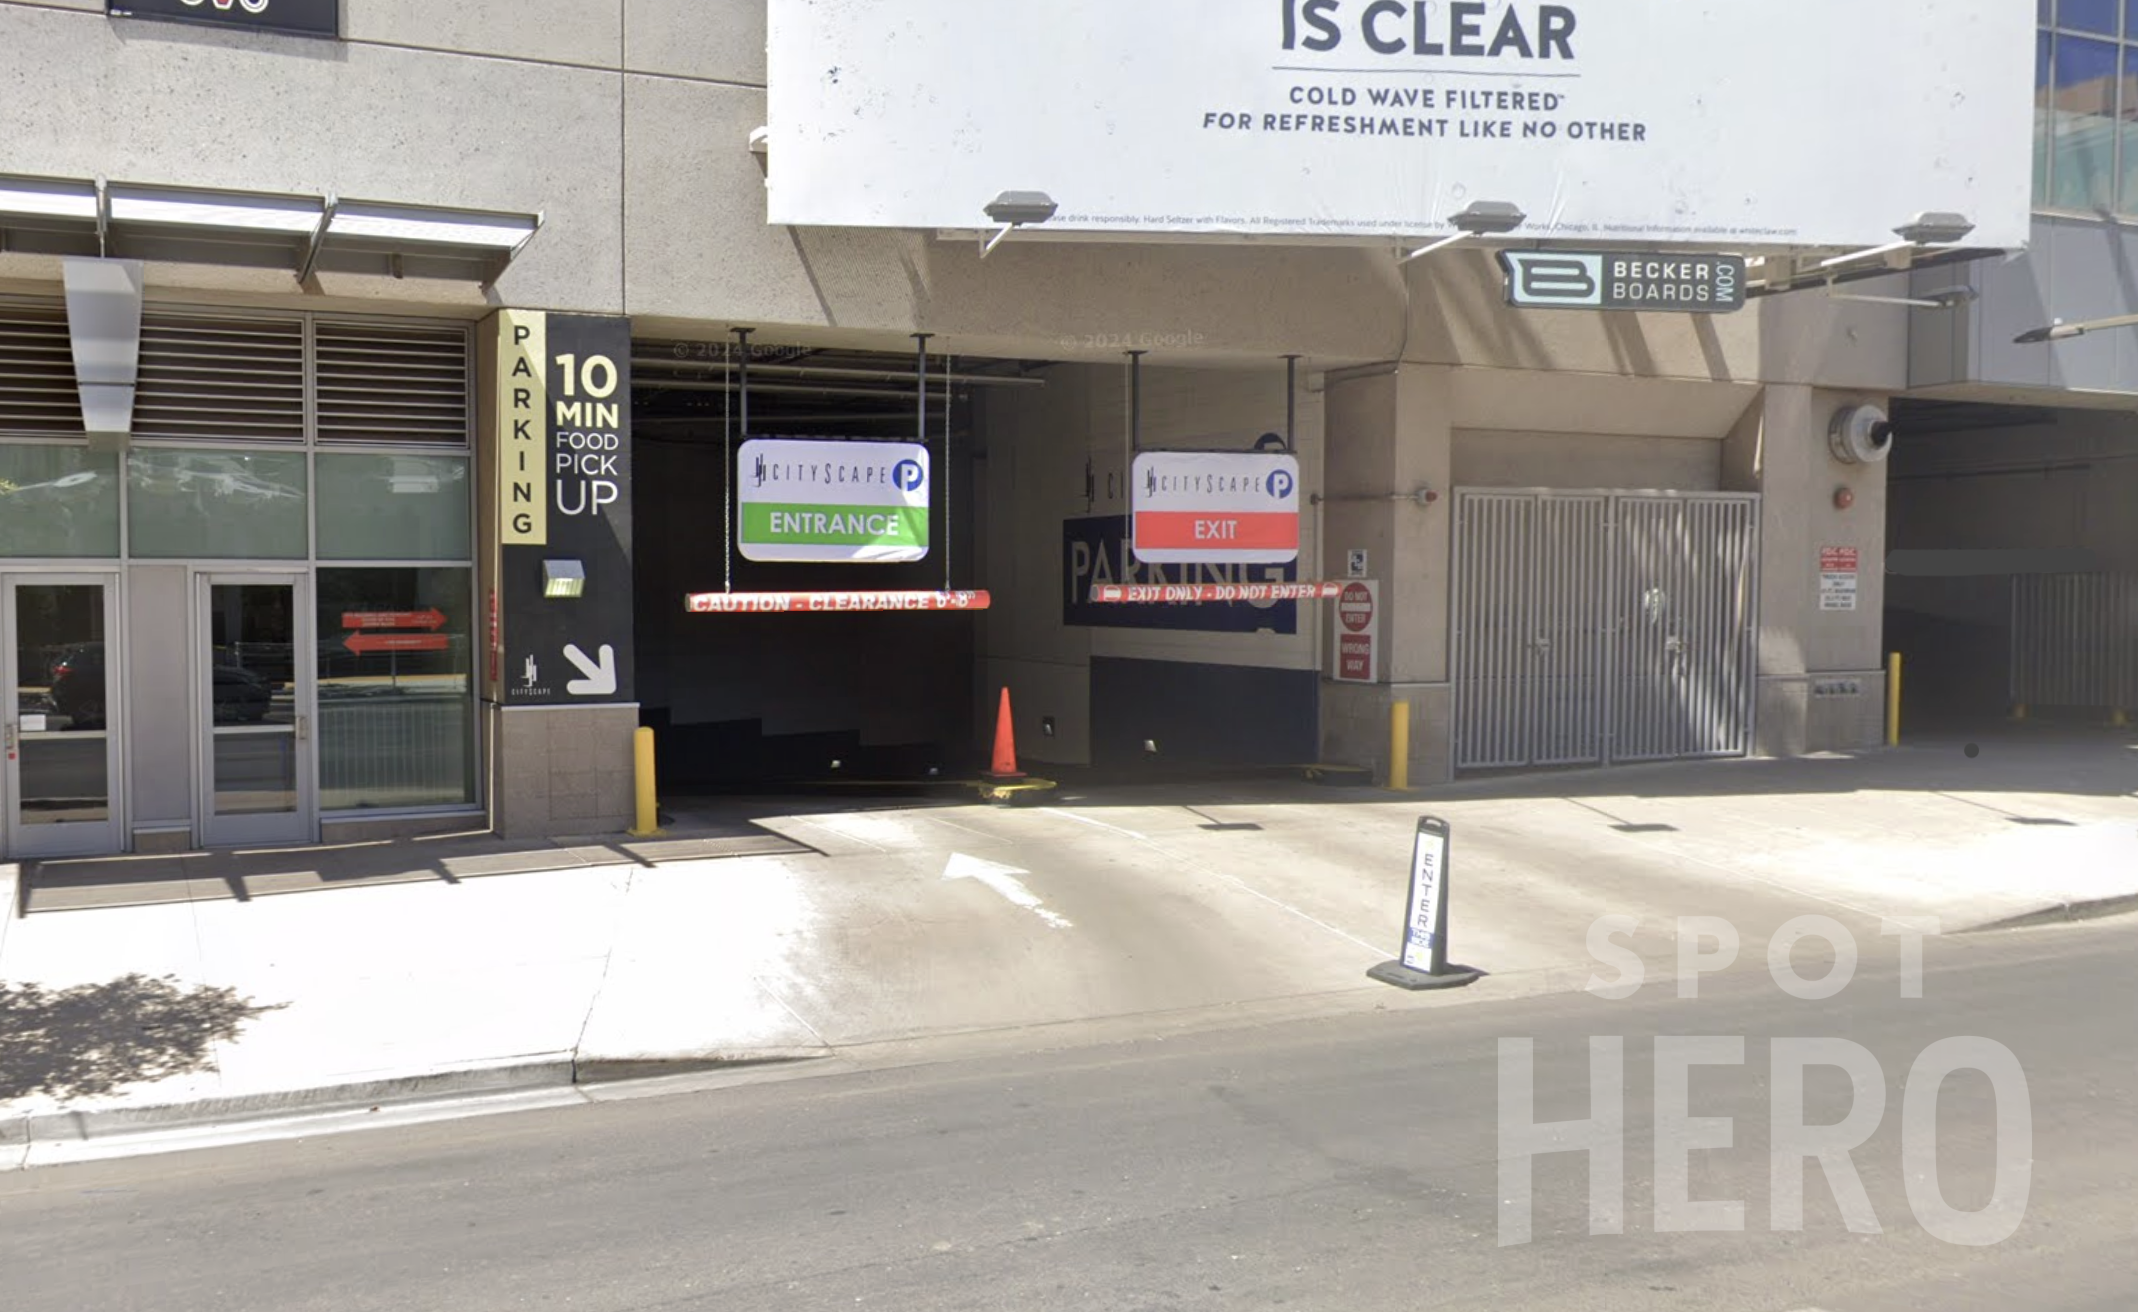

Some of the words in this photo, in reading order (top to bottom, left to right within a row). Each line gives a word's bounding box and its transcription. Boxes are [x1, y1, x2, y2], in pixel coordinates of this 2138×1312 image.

[1281, 0, 1342, 51] IS
[1362, 0, 1577, 59] CLEAR
[1289, 86, 1357, 106] COLD
[1368, 88, 1435, 108] WAVE
[1203, 112, 1252, 130] FOR
[1263, 113, 1448, 138] REFRESHMENT
[1459, 120, 1512, 139] LIKE
[1523, 121, 1556, 139] NO
[1567, 122, 1647, 142] OTHER
[1068, 214, 1088, 223] drink
[1144, 214, 1165, 224] Hard
[1166, 215, 1193, 224] Seltzer
[1196, 215, 1213, 224] with
[1614, 261, 1710, 280] BECKER
[1715, 261, 1734, 303] .COM
[1613, 282, 1710, 301] BOARDS
[555, 353, 618, 399] 10
[556, 401, 619, 429] MIN
[512, 325, 532, 534] PARKING
[556, 431, 619, 450] FOOD
[556, 453, 618, 476] PICK
[556, 479, 618, 515] UP
[769, 512, 900, 536] ENTRANCE
[1194, 519, 1238, 539] EXIT
[692, 594, 790, 611] CAUTION
[808, 593, 929, 611] CLEARANCE
[1127, 585, 1162, 601] EXIT
[1165, 585, 1203, 600] ONLY
[1215, 585, 1235, 600] DO
[1239, 584, 1267, 599] NOT
[1271, 584, 1316, 599] ENTER
[1417, 853, 1435, 928] ENTER
